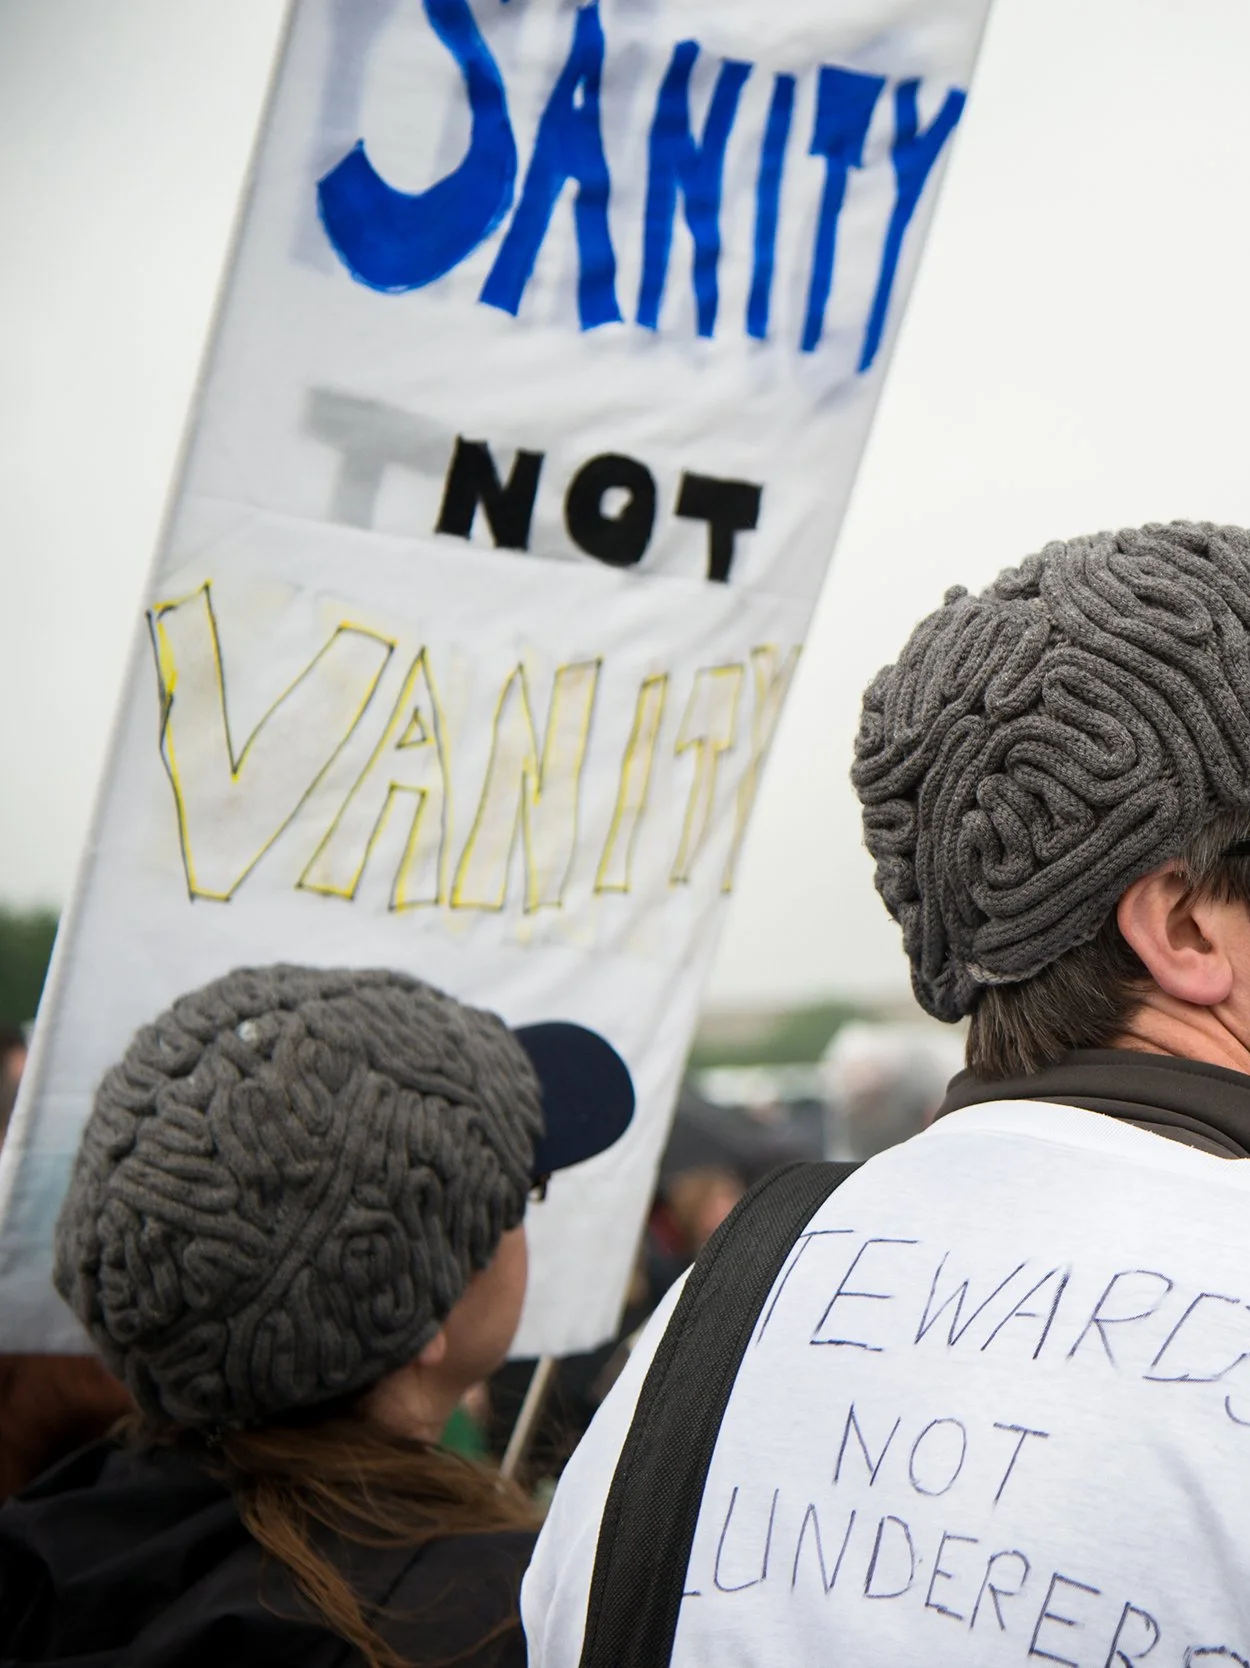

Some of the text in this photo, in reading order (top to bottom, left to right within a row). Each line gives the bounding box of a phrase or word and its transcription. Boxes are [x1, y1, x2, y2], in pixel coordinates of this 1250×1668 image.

[317, 0, 966, 373] SANITY
[434, 434, 763, 583] NOT
[146, 579, 803, 914] VANITY
[832, 1401, 1049, 1506] NOT
[683, 1486, 1250, 1668] UNDERER
